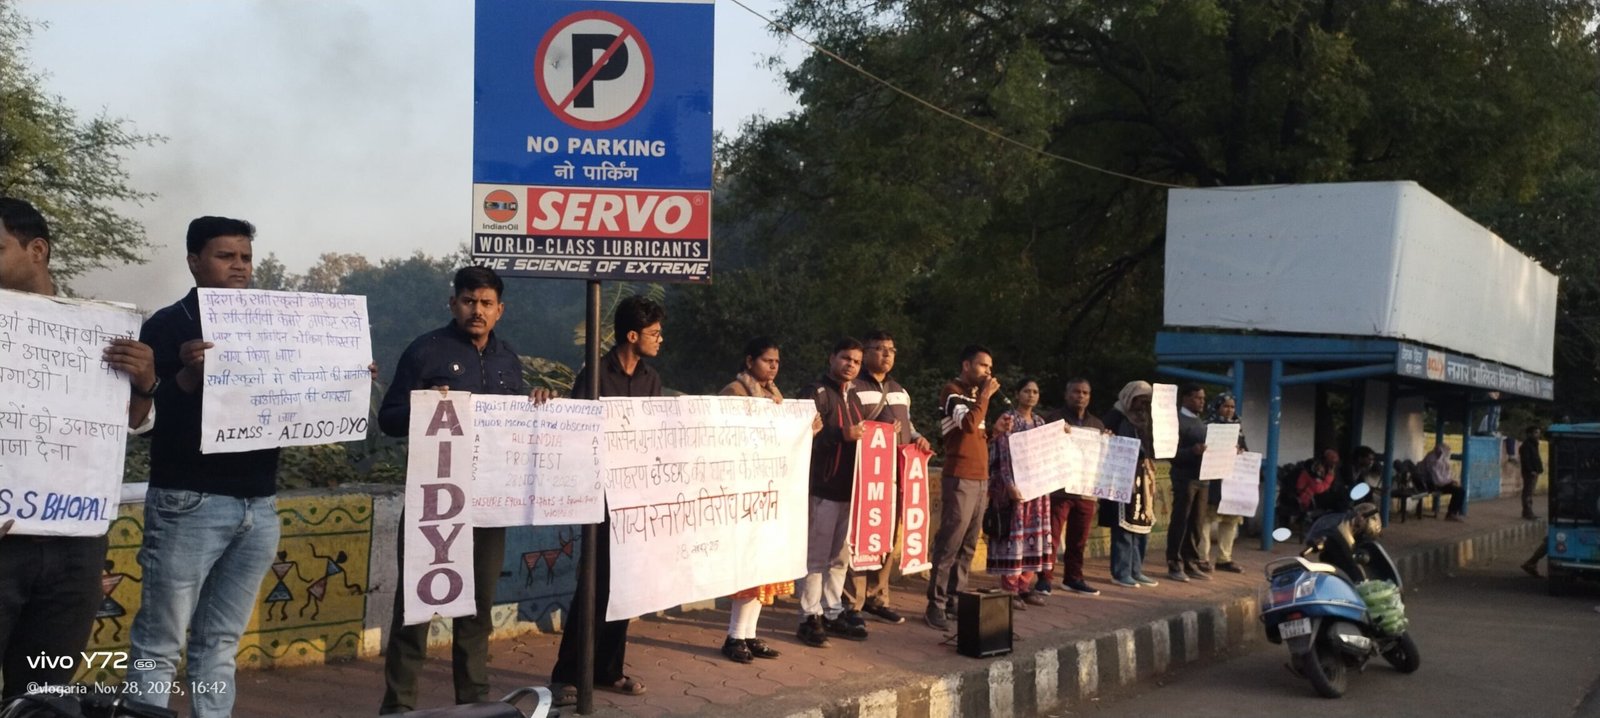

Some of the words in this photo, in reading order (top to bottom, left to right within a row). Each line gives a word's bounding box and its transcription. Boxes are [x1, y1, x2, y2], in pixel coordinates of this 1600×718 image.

[527, 135, 559, 154] NO
[568, 138, 666, 158] PARKING
[553, 160, 575, 180] नो
[582, 161, 639, 182] पार्किंग
[531, 191, 693, 235] SERVO
[482, 223, 519, 231] IndianOil
[479, 236, 595, 256] WORLD-CLASS
[603, 239, 701, 259] LUBRICANTS
[471, 258, 507, 271] THE
[513, 259, 591, 273] SCIENCE
[596, 261, 621, 274] OF
[625, 262, 709, 275] EXTREME
[29, 406, 58, 434] को
[215, 426, 264, 443] AIMSS
[505, 450, 563, 470] PROTEST
[867, 427, 887, 553] AIMSS
[41, 492, 108, 521] BHOPAL
[417, 399, 466, 606] AIDYO
